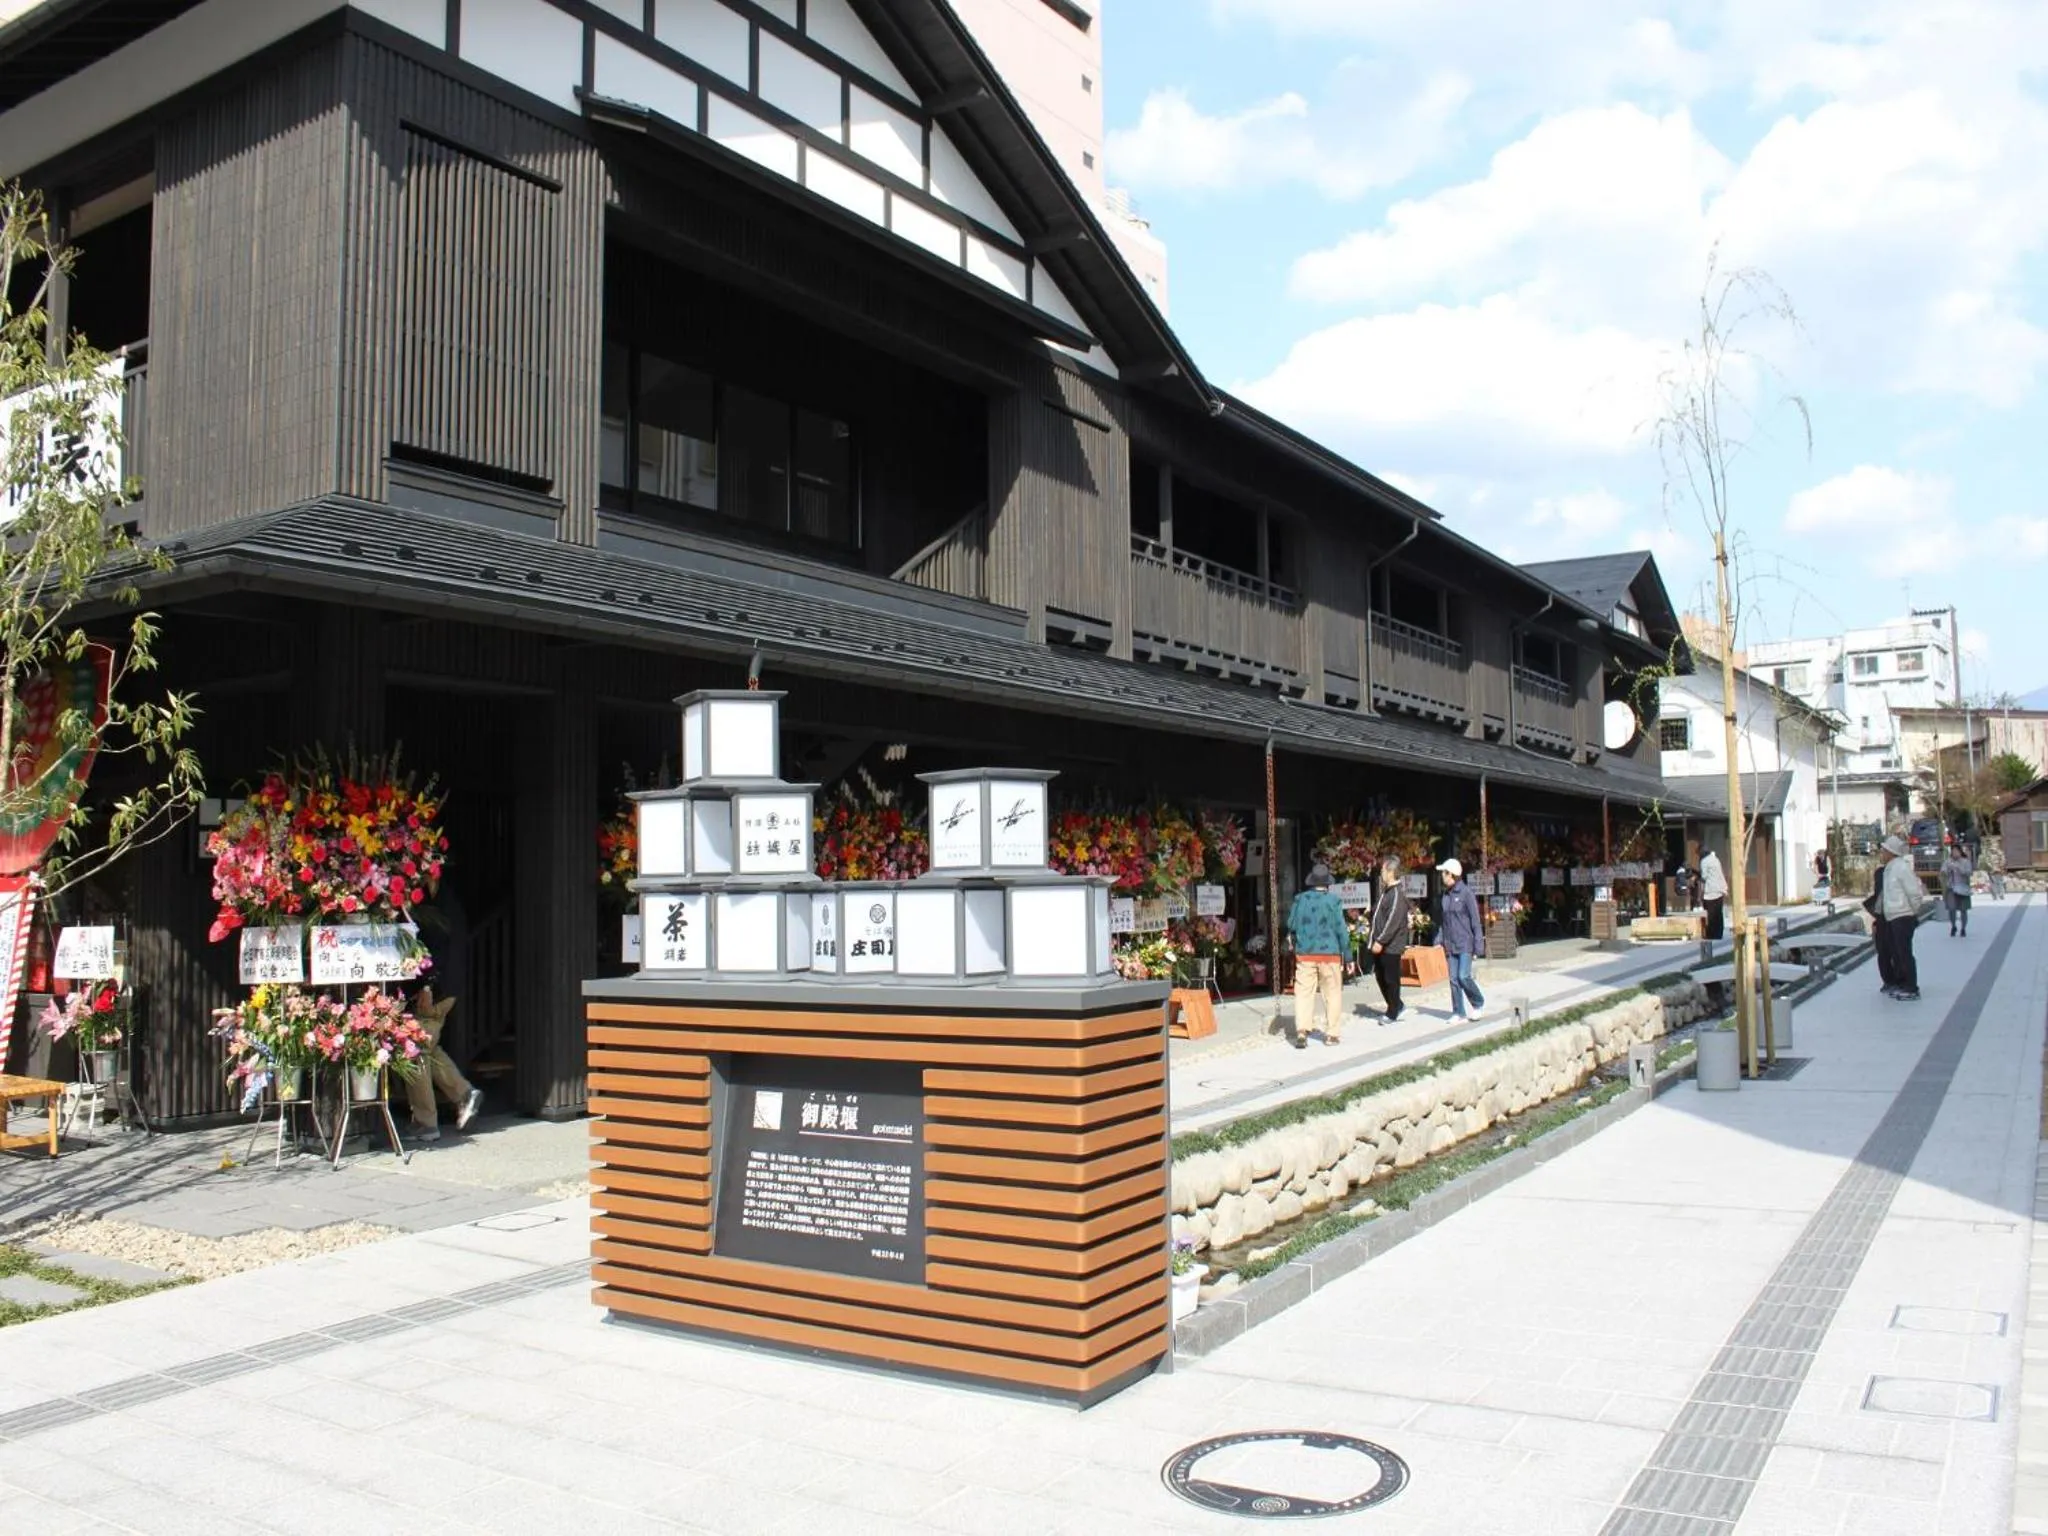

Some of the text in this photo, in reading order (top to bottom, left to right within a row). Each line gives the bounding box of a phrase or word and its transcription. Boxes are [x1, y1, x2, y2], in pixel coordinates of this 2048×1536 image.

[662, 902, 688, 942] 茶
[801, 1101, 860, 1131] 御殿堰
